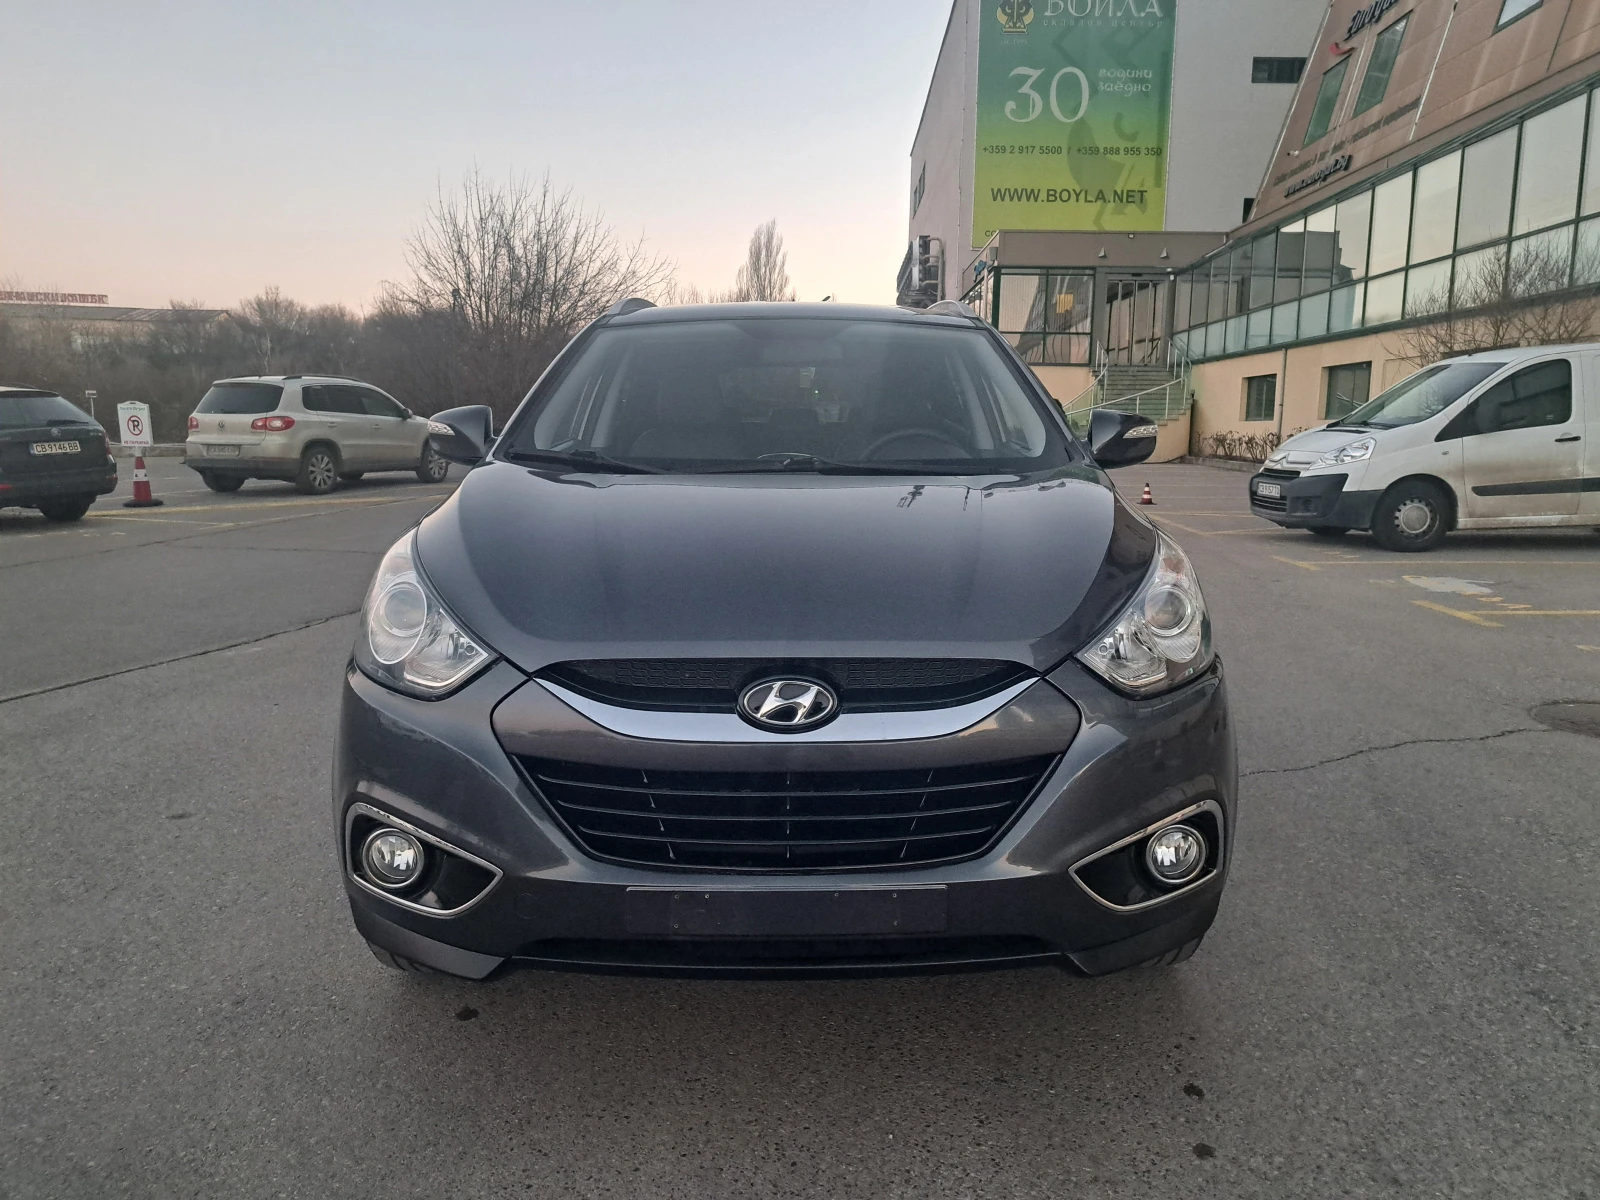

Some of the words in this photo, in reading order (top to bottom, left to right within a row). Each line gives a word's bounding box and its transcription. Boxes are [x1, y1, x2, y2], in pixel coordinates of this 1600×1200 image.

[1004, 66, 1090, 123] 30
[982, 145, 1006, 154] +359
[1009, 145, 1015, 154] 2
[1018, 145, 1035, 155] 917
[1038, 145, 1062, 155] 5500
[1076, 146, 1100, 155] +359
[1102, 146, 1121, 156] 888
[1123, 146, 1141, 156] 955
[1143, 147, 1162, 156] 350
[991, 187, 1148, 204] WWW.BOYLA.NET
